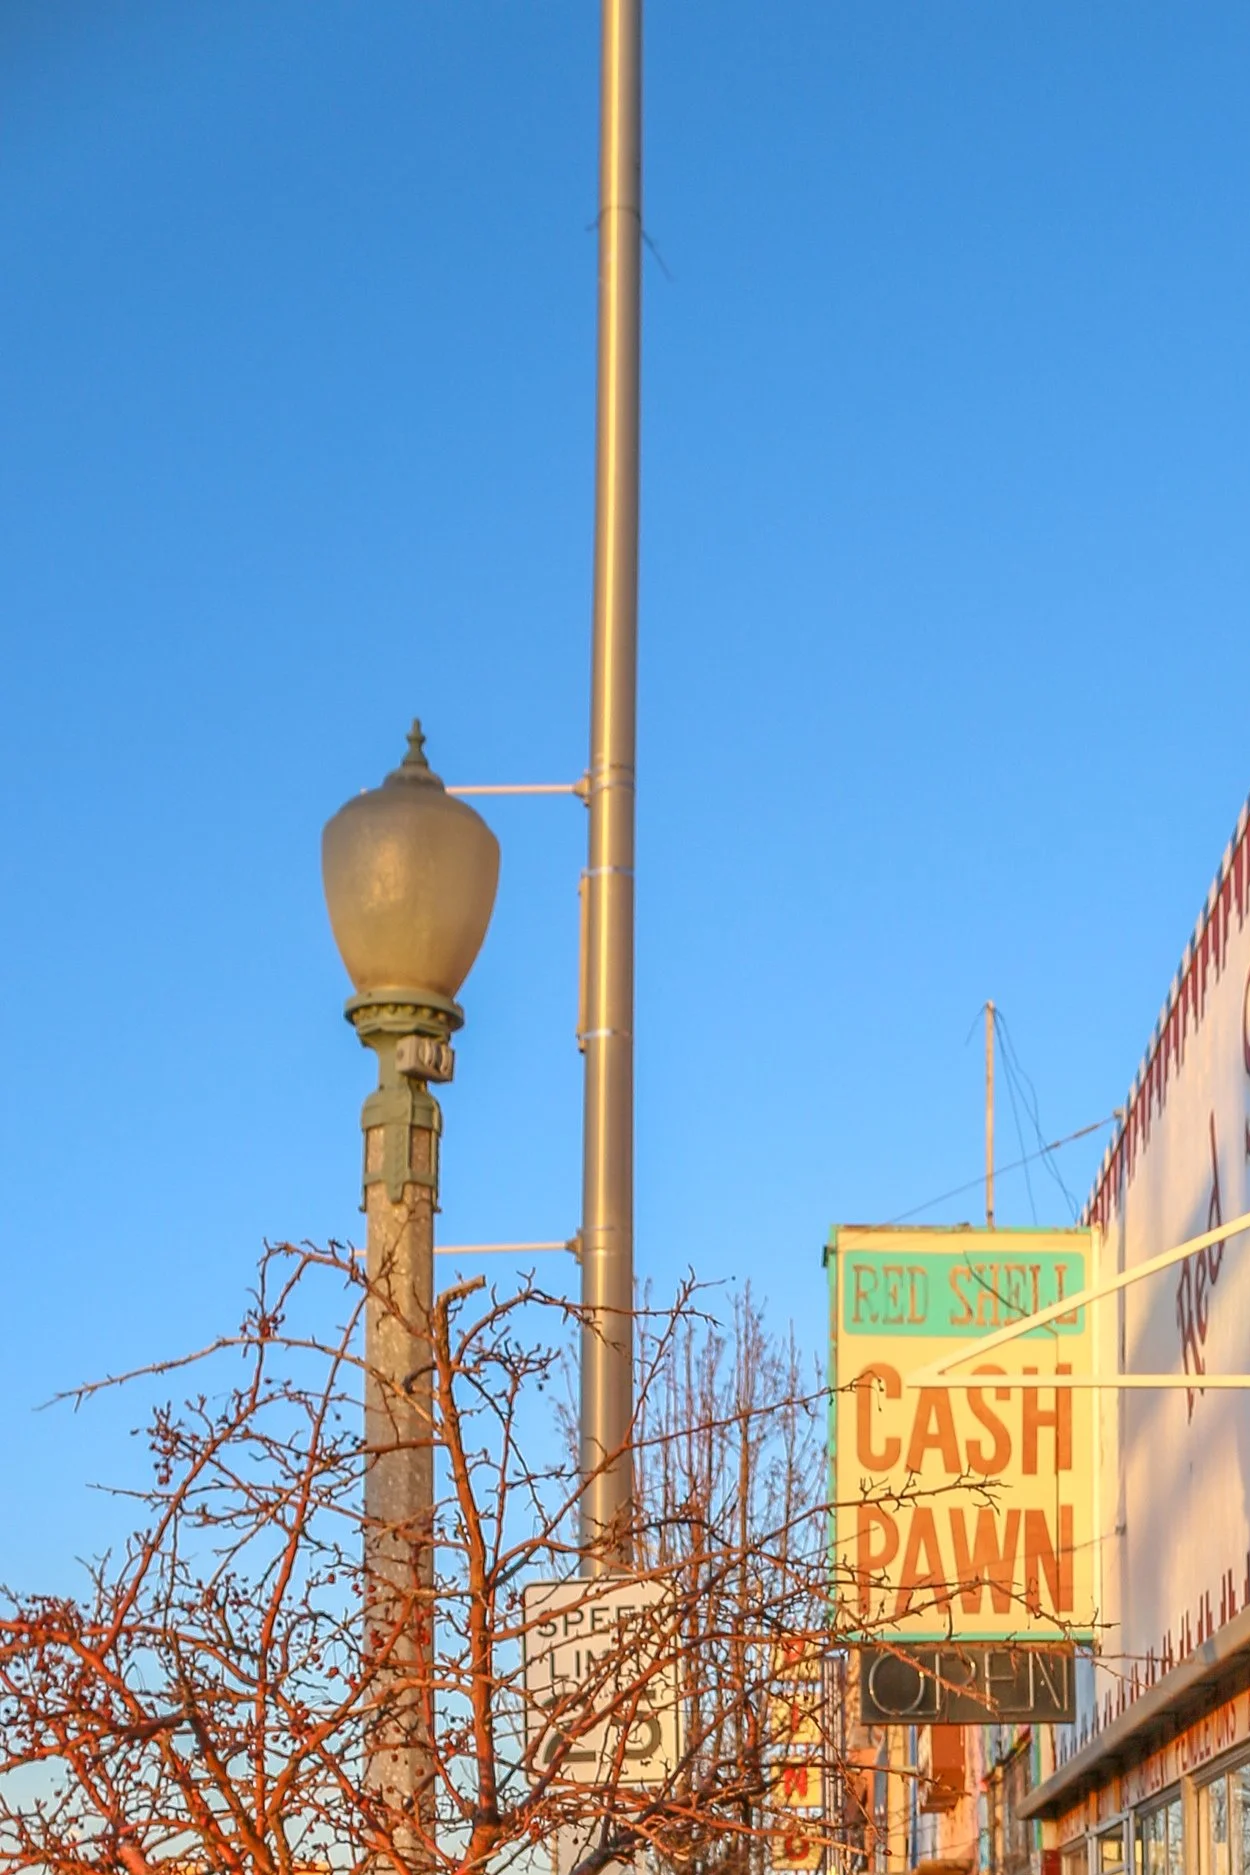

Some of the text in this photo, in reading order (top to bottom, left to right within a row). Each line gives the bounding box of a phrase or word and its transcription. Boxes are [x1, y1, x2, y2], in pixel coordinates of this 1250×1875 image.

[852, 1264, 1080, 1326] RED SHELL
[1175, 1108, 1224, 1426] Red
[856, 1362, 1072, 1476] CASH
[855, 1505, 1074, 1616] PAWN
[536, 1603, 661, 1638] SPEE
[868, 1650, 1067, 1716] OPEN
